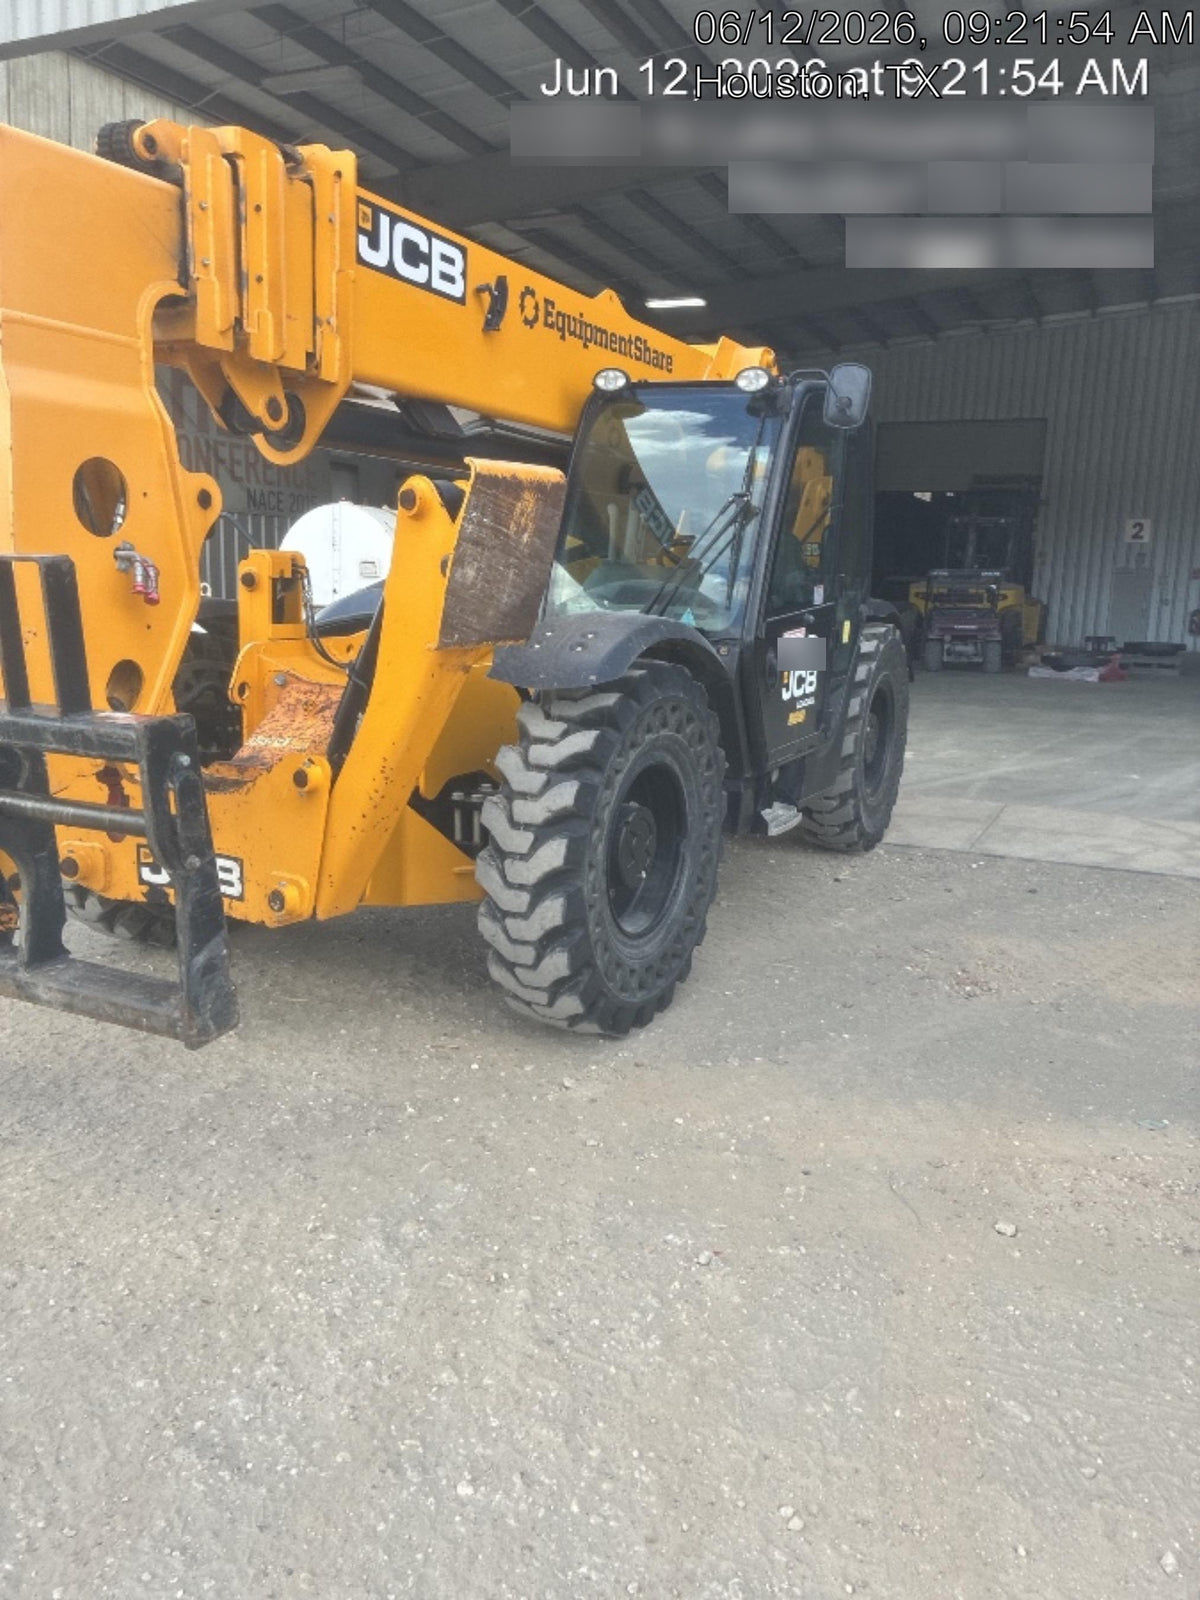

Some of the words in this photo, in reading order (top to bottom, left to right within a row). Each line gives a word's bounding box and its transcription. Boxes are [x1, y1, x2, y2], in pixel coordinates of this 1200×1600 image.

[358, 212, 465, 298] JCB
[543, 297, 674, 374] EquipmentShare
[246, 486, 285, 513] NACE
[1131, 521, 1145, 539] 2
[781, 670, 818, 701] JCB
[140, 857, 243, 897] JB
